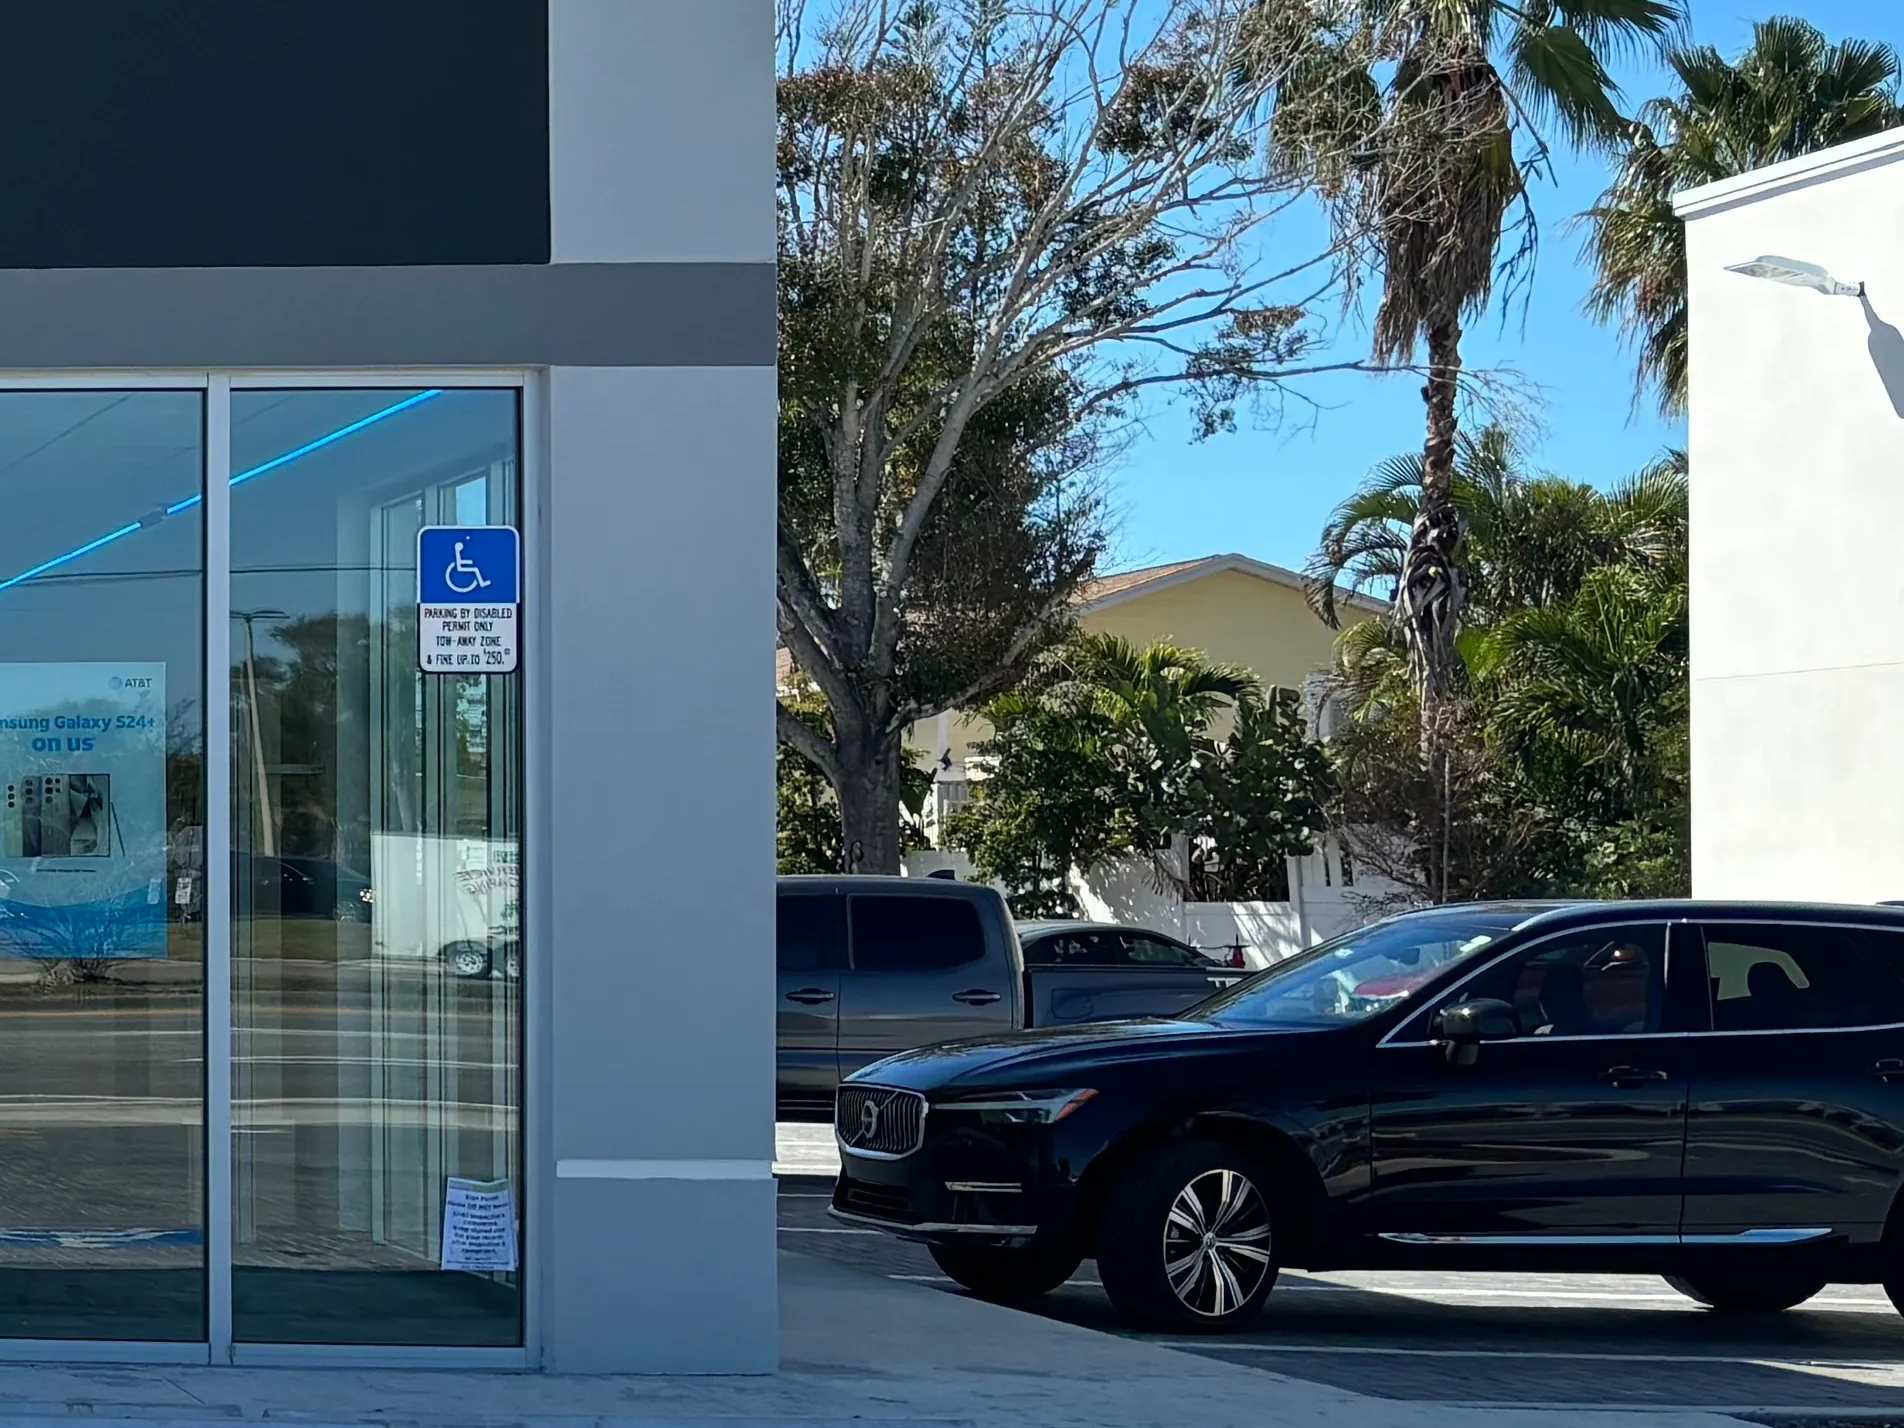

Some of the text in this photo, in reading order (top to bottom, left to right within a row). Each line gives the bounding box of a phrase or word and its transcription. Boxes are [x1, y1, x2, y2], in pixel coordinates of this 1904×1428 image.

[423, 608, 513, 619] PARKING BY DISABLED
[442, 621, 494, 632] PERMIT ONLY
[436, 636, 502, 647] TOW-AWAY ZONE
[435, 654, 454, 665] FINE
[124, 677, 153, 689] AT&T
[54, 715, 112, 732] Galaxy
[115, 715, 154, 730] S24+
[31, 737, 95, 753] on us
